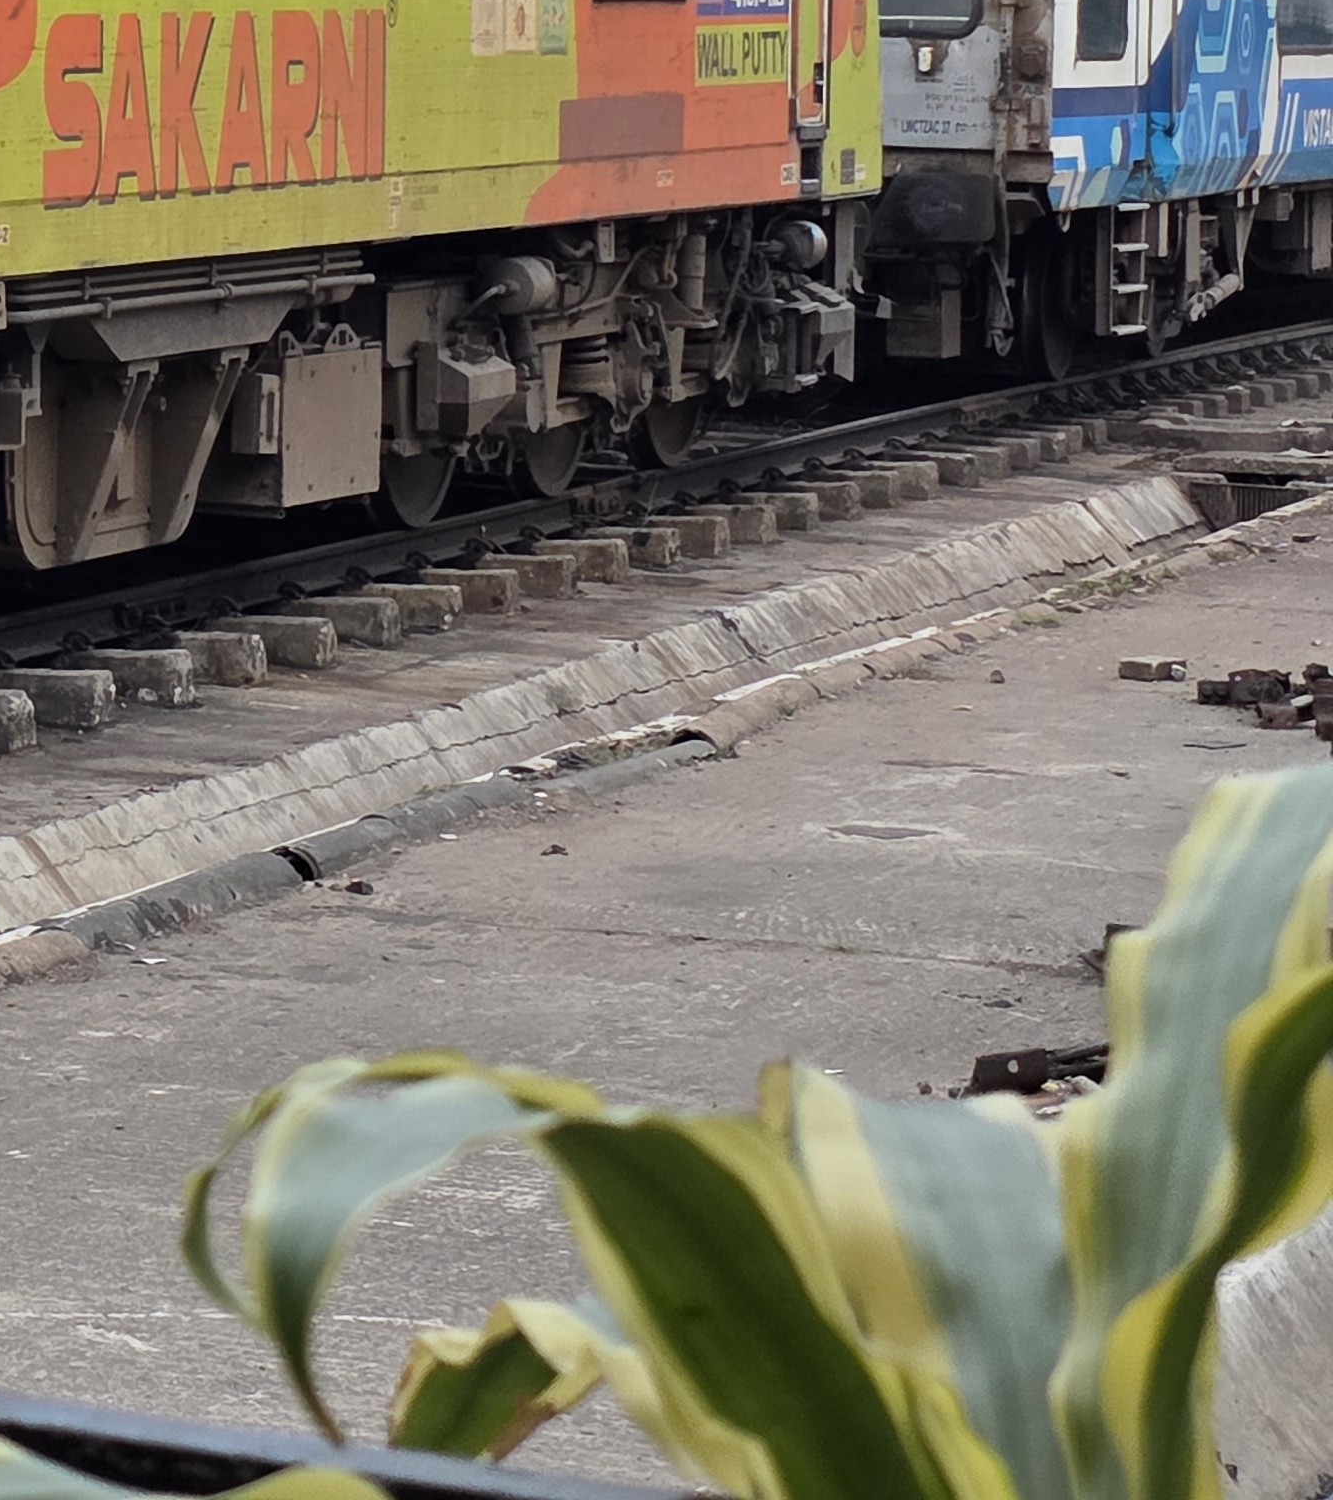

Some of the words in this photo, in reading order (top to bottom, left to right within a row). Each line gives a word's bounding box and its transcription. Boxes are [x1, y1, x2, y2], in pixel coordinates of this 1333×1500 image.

[41, 7, 386, 210] SAKARNI
[696, 33, 738, 79] WALL
[742, 30, 790, 75] PUTTY
